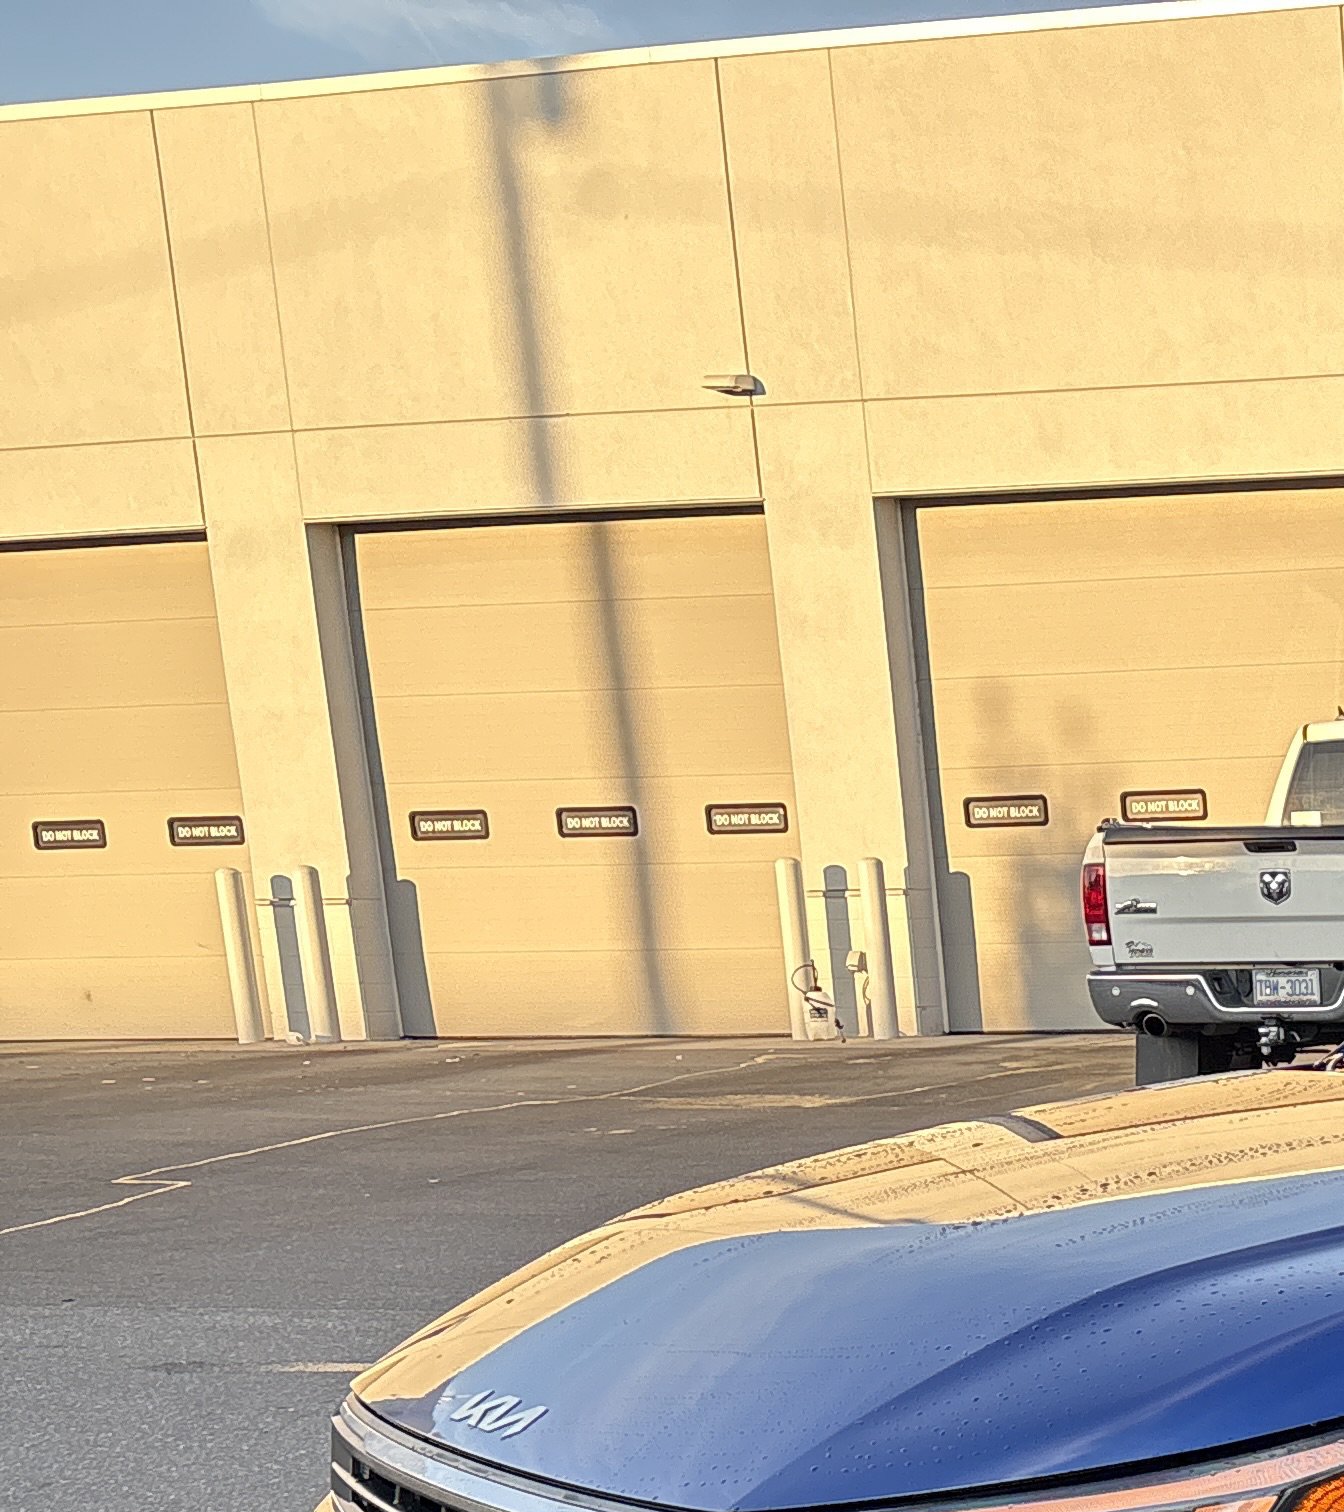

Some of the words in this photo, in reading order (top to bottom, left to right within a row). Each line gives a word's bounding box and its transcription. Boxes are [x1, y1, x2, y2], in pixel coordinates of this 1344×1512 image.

[974, 807, 988, 819] DO
[989, 806, 1008, 818] NOT
[1009, 805, 1040, 818] BLOCK
[1131, 802, 1146, 813] DO
[1148, 801, 1167, 812] NOT
[1167, 799, 1200, 812] BLOCK
[419, 821, 433, 832] DO
[434, 820, 452, 831] NOT
[453, 820, 482, 831] BLOCK
[566, 817, 580, 829] DO
[581, 817, 600, 828] NOT
[601, 816, 630, 827] BLOCK
[715, 814, 729, 826] DO
[730, 814, 750, 825] NOT
[750, 813, 780, 825] BLOCK
[41, 830, 55, 841] DO
[55, 829, 72, 841] NOT
[72, 829, 100, 841] BLOCK
[178, 826, 191, 838] DO
[192, 826, 209, 837] NOT
[210, 825, 238, 837] BLOCK
[449, 1388, 550, 1442] KIA
